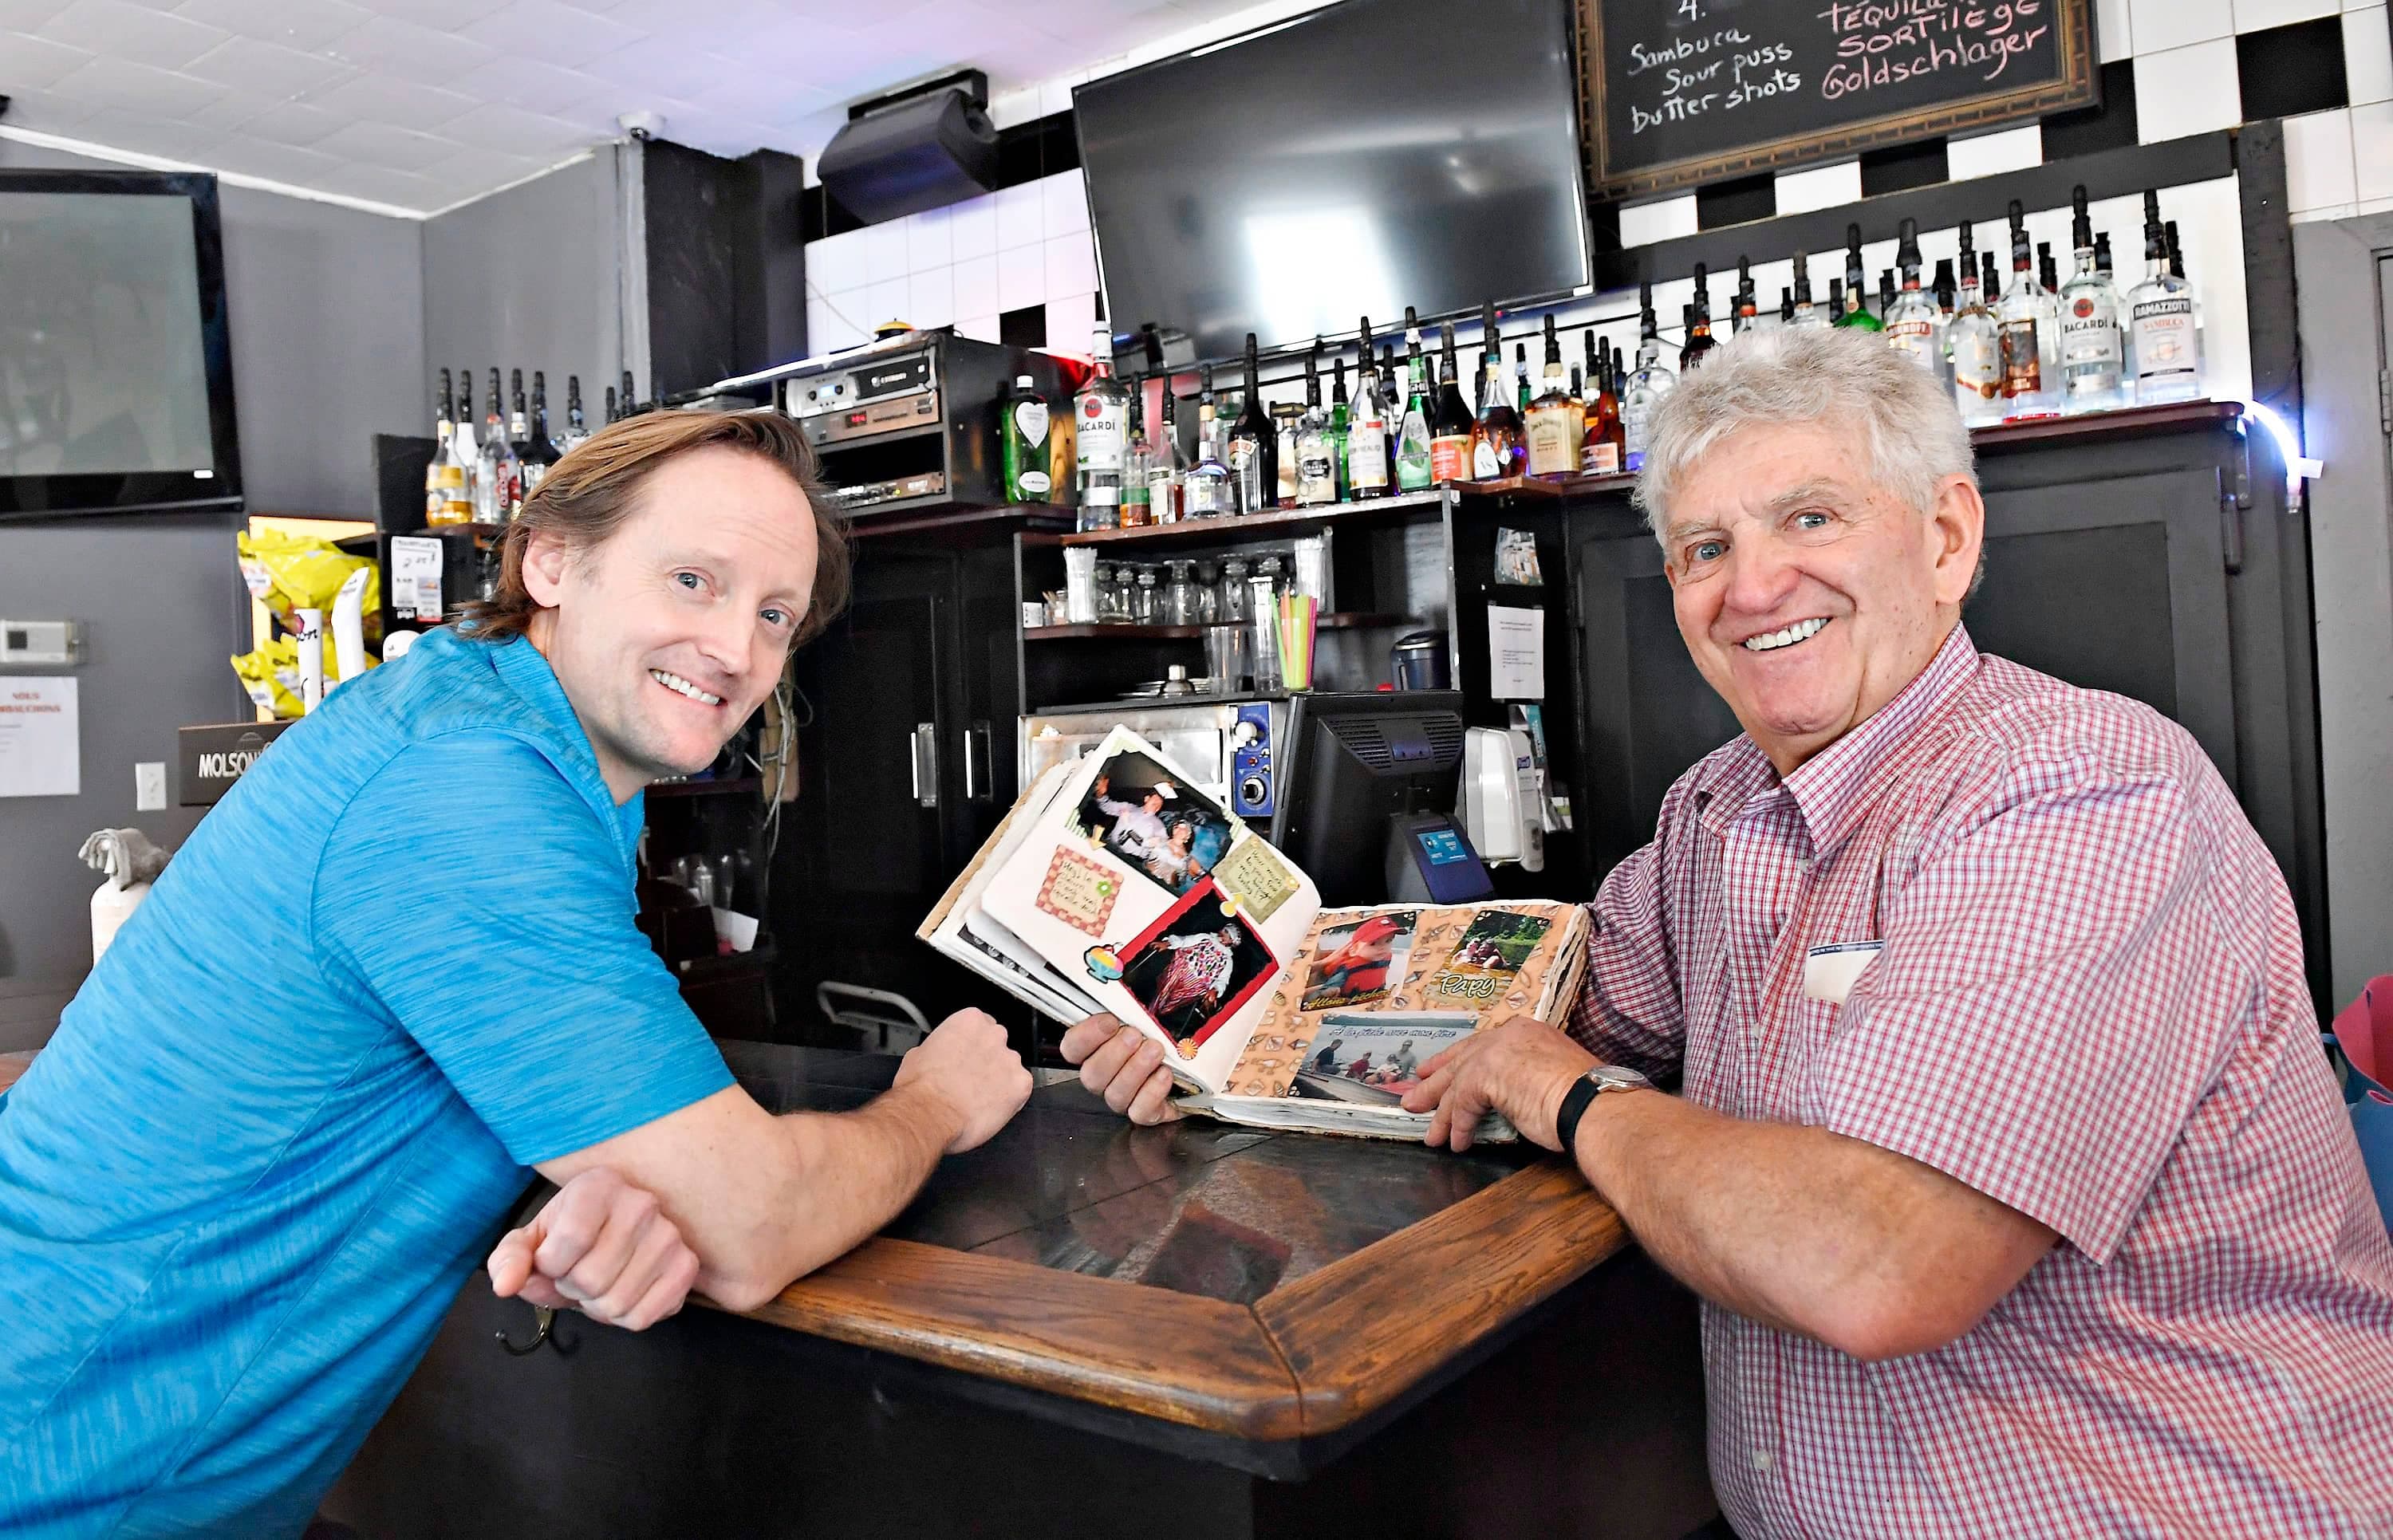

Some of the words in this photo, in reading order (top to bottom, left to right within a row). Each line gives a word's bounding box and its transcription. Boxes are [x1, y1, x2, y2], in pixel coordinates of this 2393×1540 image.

[1627, 29, 1751, 76] Sambuca
[1662, 60, 1725, 96] Sour
[1732, 42, 1793, 84] puss
[1821, 25, 2048, 100] Goldschlager
[1631, 93, 1720, 134] butter
[1725, 69, 1801, 109] shots
[1440, 974, 1497, 998] Papy
